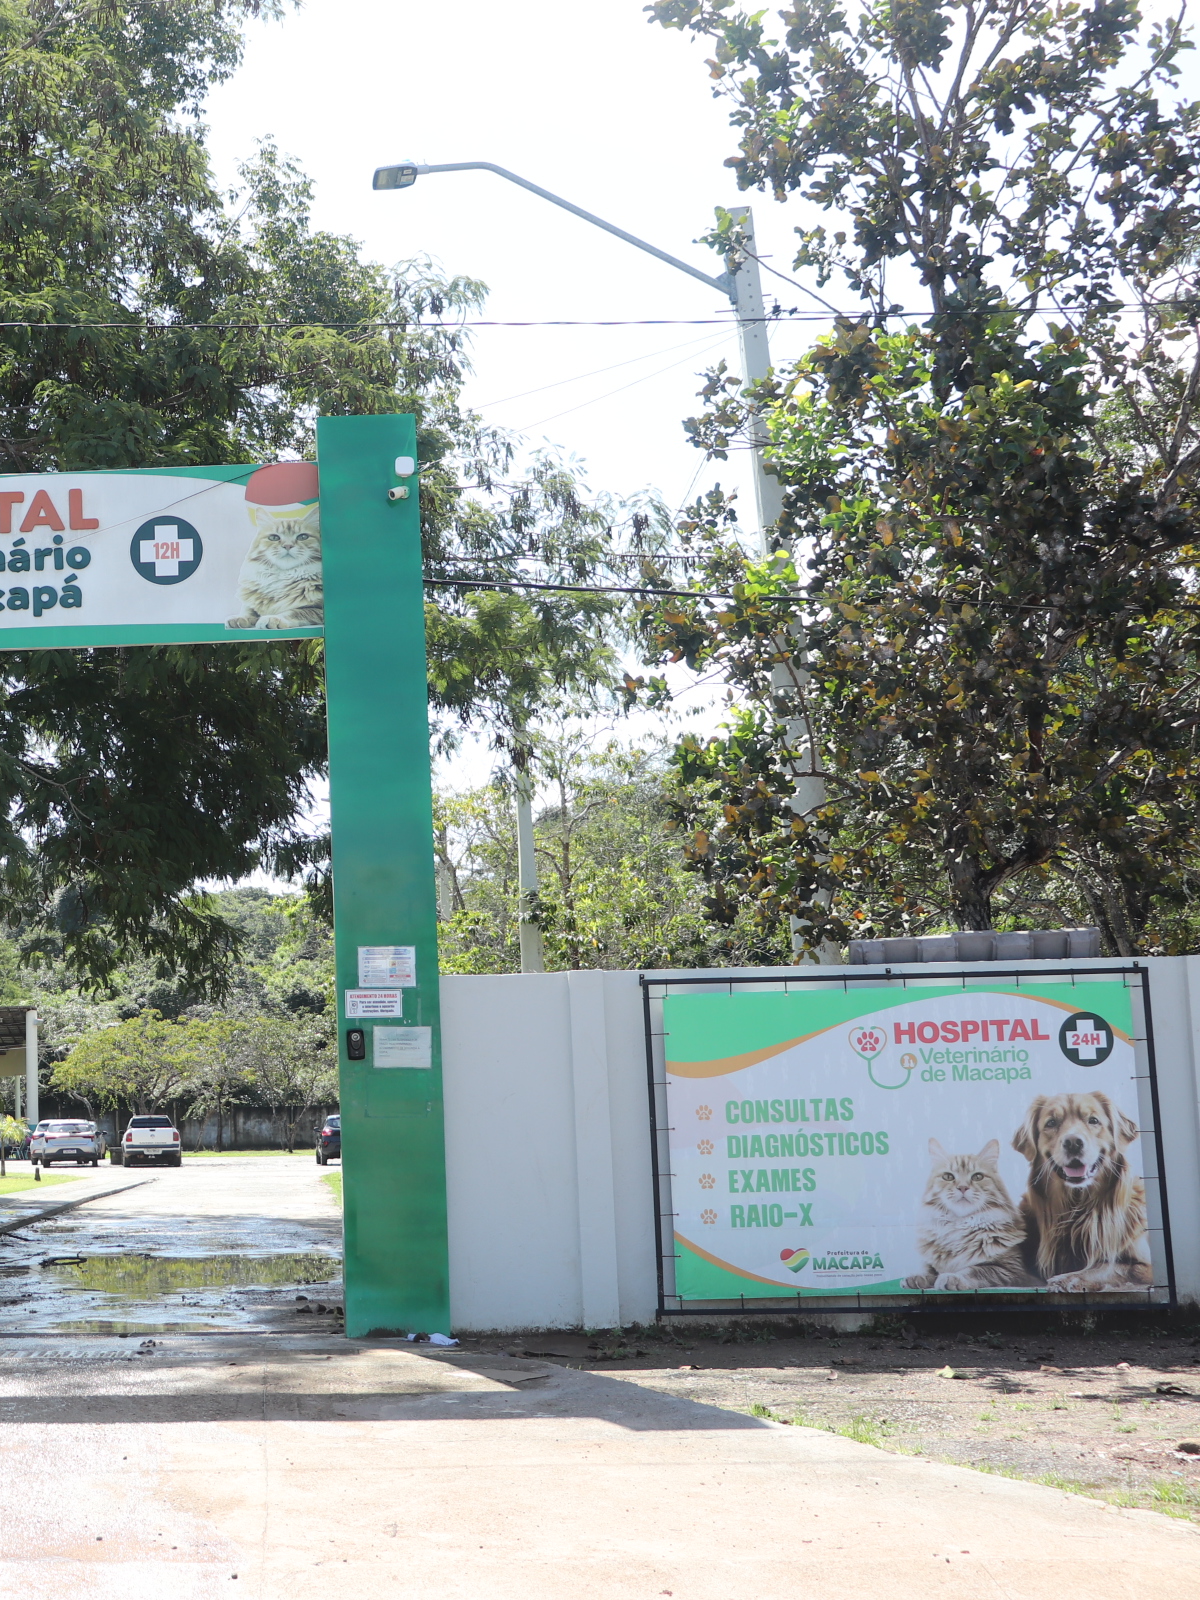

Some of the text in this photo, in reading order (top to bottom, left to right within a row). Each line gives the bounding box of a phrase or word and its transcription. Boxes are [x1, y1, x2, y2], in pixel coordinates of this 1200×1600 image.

[152, 541, 181, 560] 12H
[893, 1019, 1050, 1044] HOSPITAL
[1071, 1033, 1100, 1046] 24H
[919, 1046, 1029, 1065] Veterinário
[920, 1063, 1032, 1085] de Macapá
[725, 1097, 854, 1124] CONSULTAS
[726, 1128, 890, 1159] DIAGNÓSTICOS
[728, 1168, 817, 1193] EXAMES
[730, 1203, 814, 1228] RAIO-X
[812, 1252, 884, 1271] MACAPÁ
